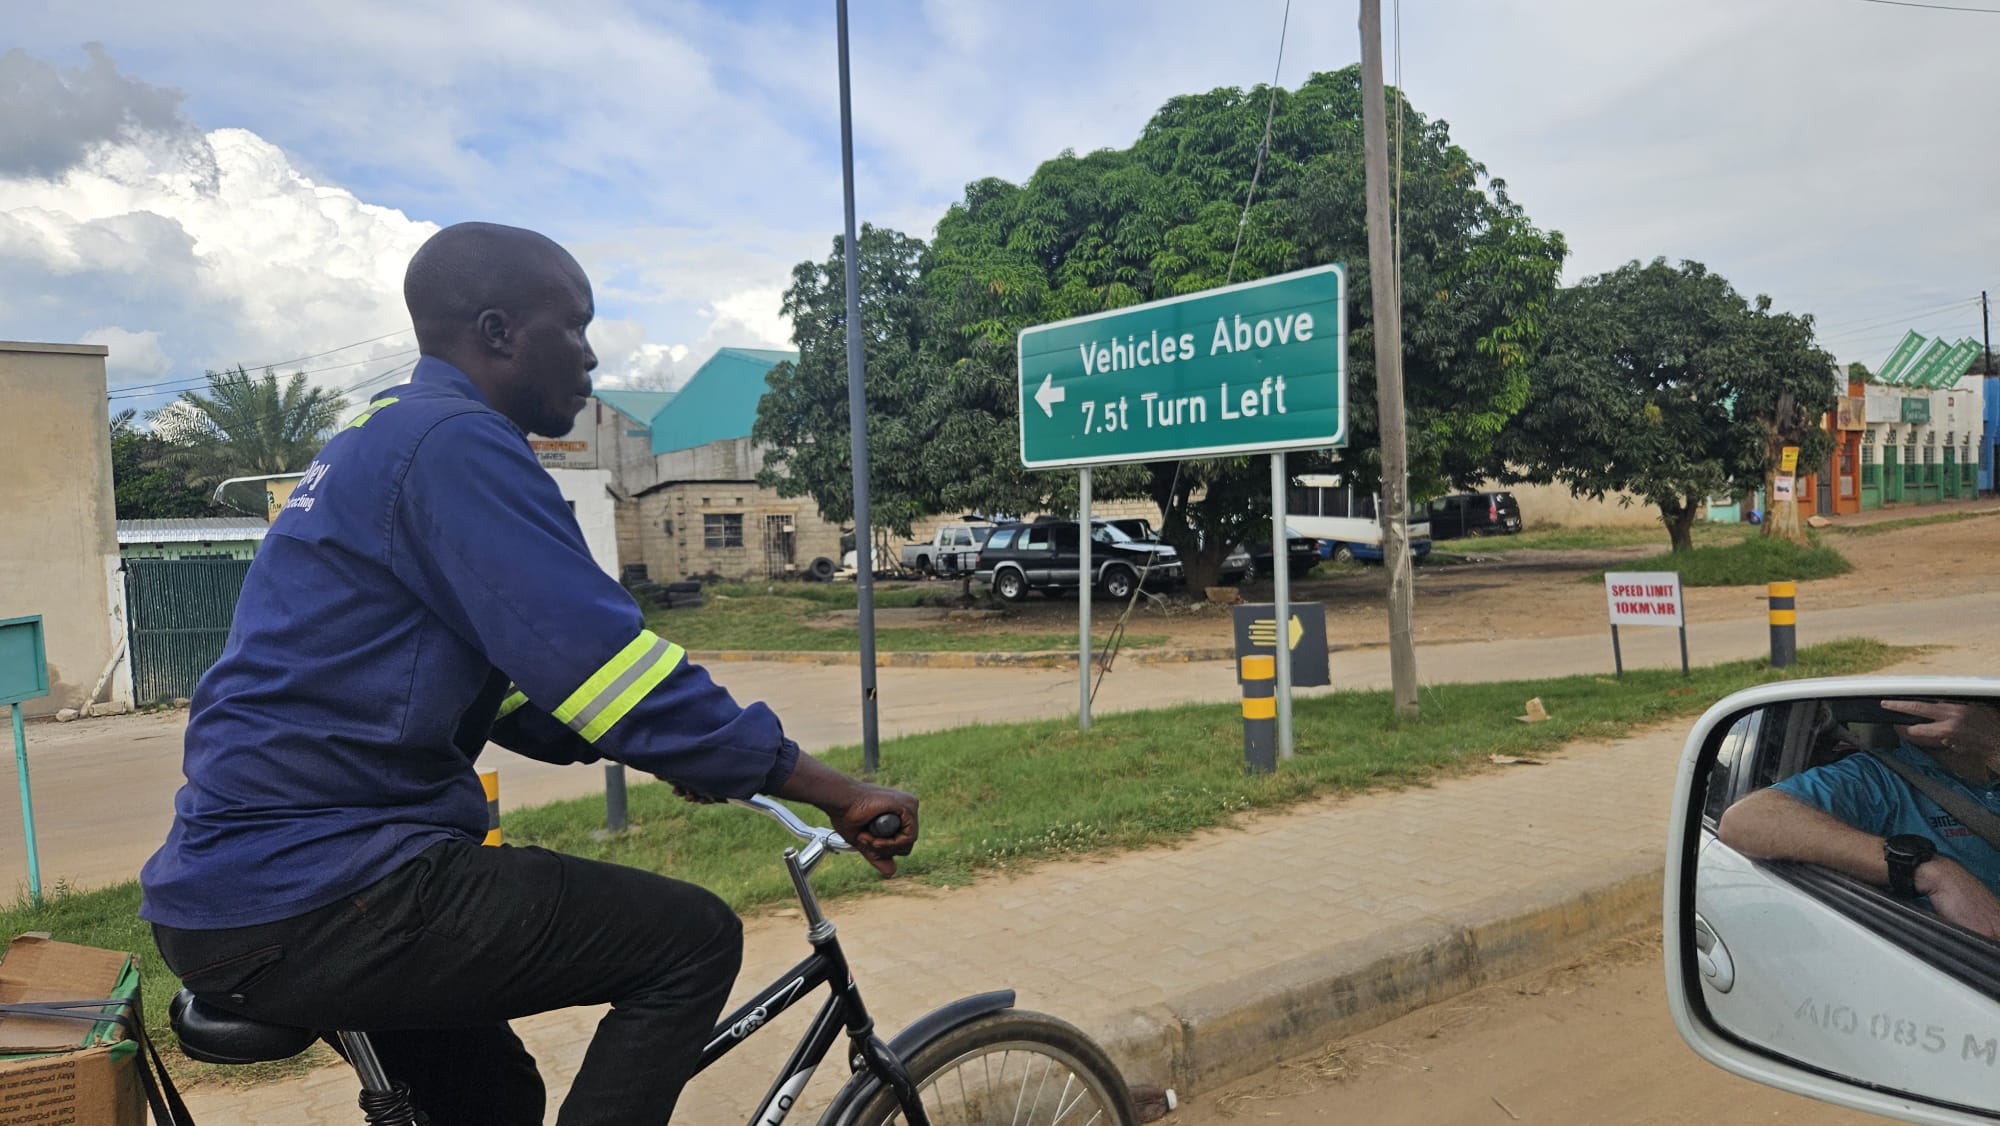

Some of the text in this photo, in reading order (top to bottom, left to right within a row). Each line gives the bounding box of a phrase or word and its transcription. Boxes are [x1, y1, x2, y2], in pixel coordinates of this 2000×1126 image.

[1080, 311, 1315, 376] Vehicles Above
[1081, 375, 1287, 435] 7.5t Turn Left
[1611, 584, 1674, 597] SPEED LIMIT
[1871, 1013, 1947, 1054] 085
[12, 1112, 49, 1124] POISON
